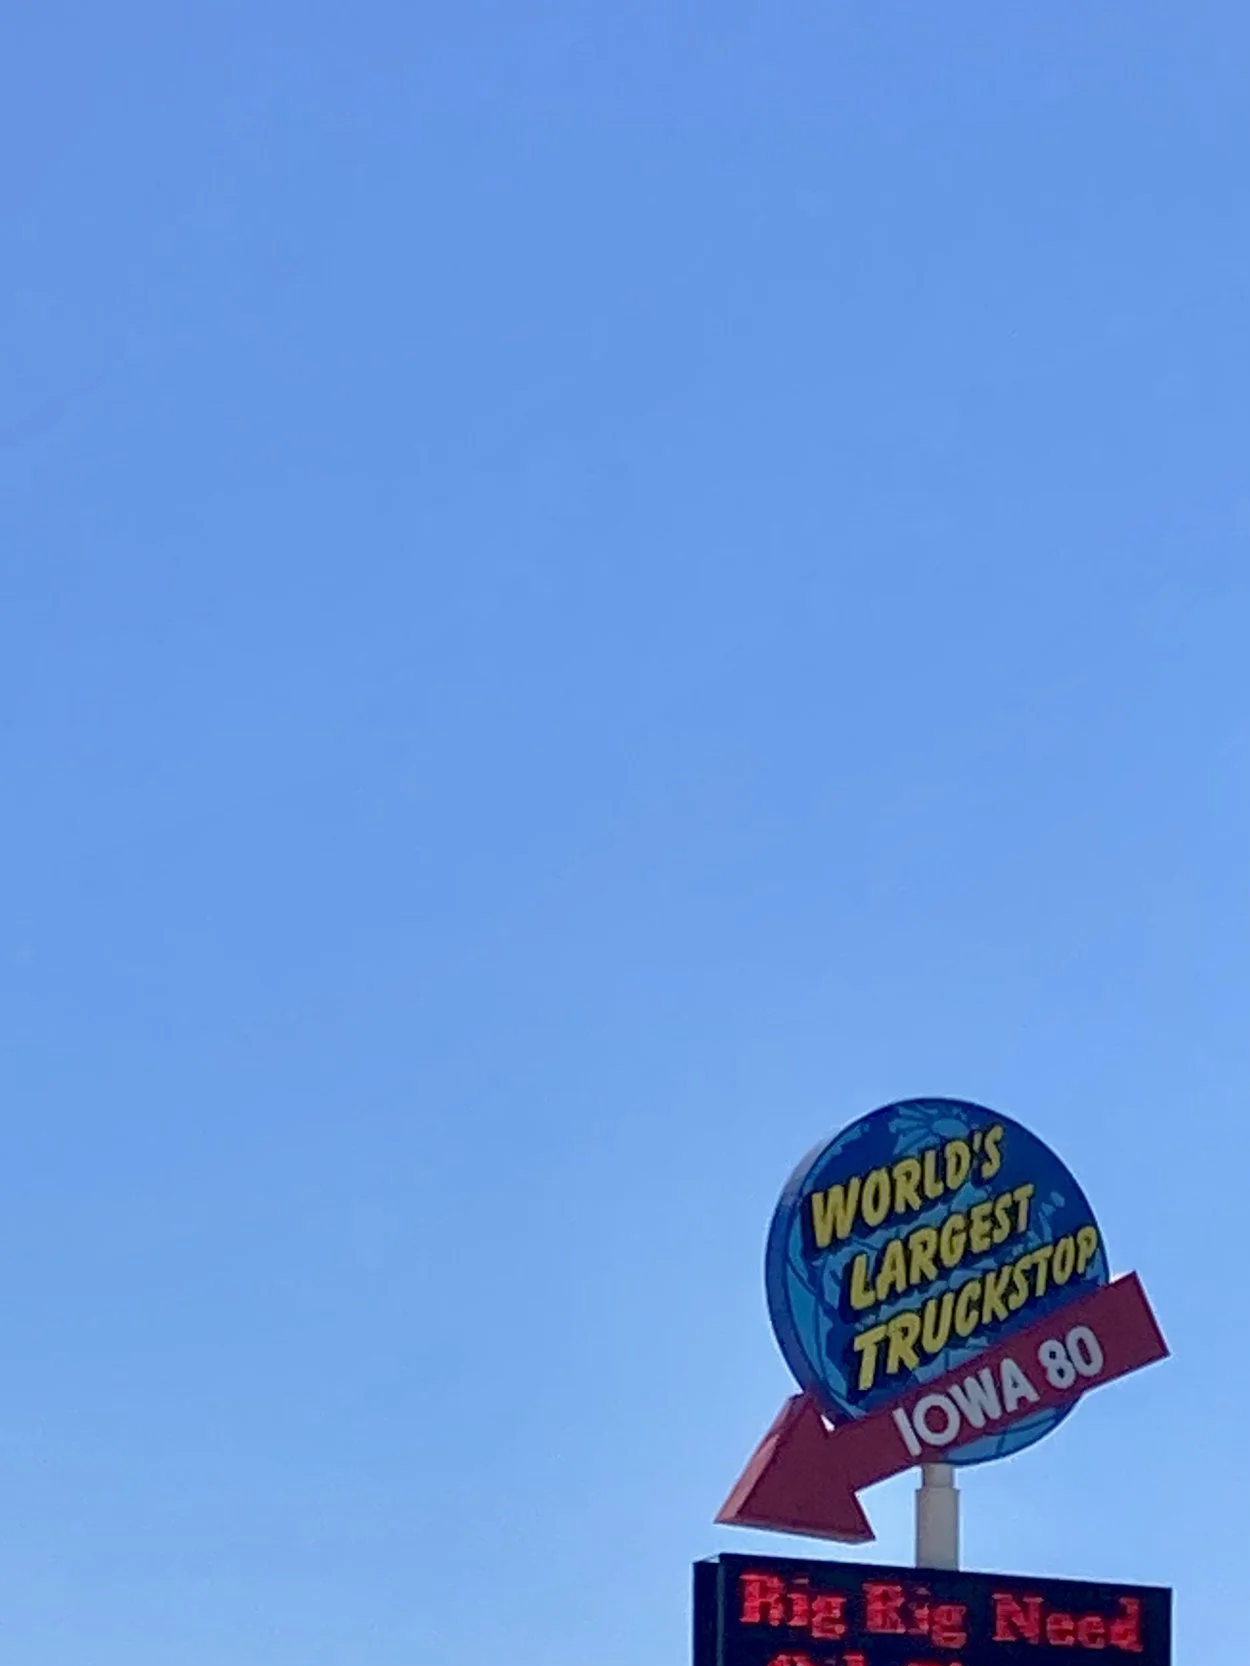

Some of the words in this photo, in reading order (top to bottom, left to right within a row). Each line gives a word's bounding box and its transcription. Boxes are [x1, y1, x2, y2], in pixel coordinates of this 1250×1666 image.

[810, 1124, 1004, 1248] WORLD'S
[849, 1182, 1035, 1308] LARGEST
[853, 1224, 1098, 1391] TRUCKSTOP
[892, 1358, 1040, 1457] IOWA
[1037, 1325, 1104, 1389] 80
[862, 1581, 967, 1649] Rig
[991, 1592, 1143, 1652] Need
